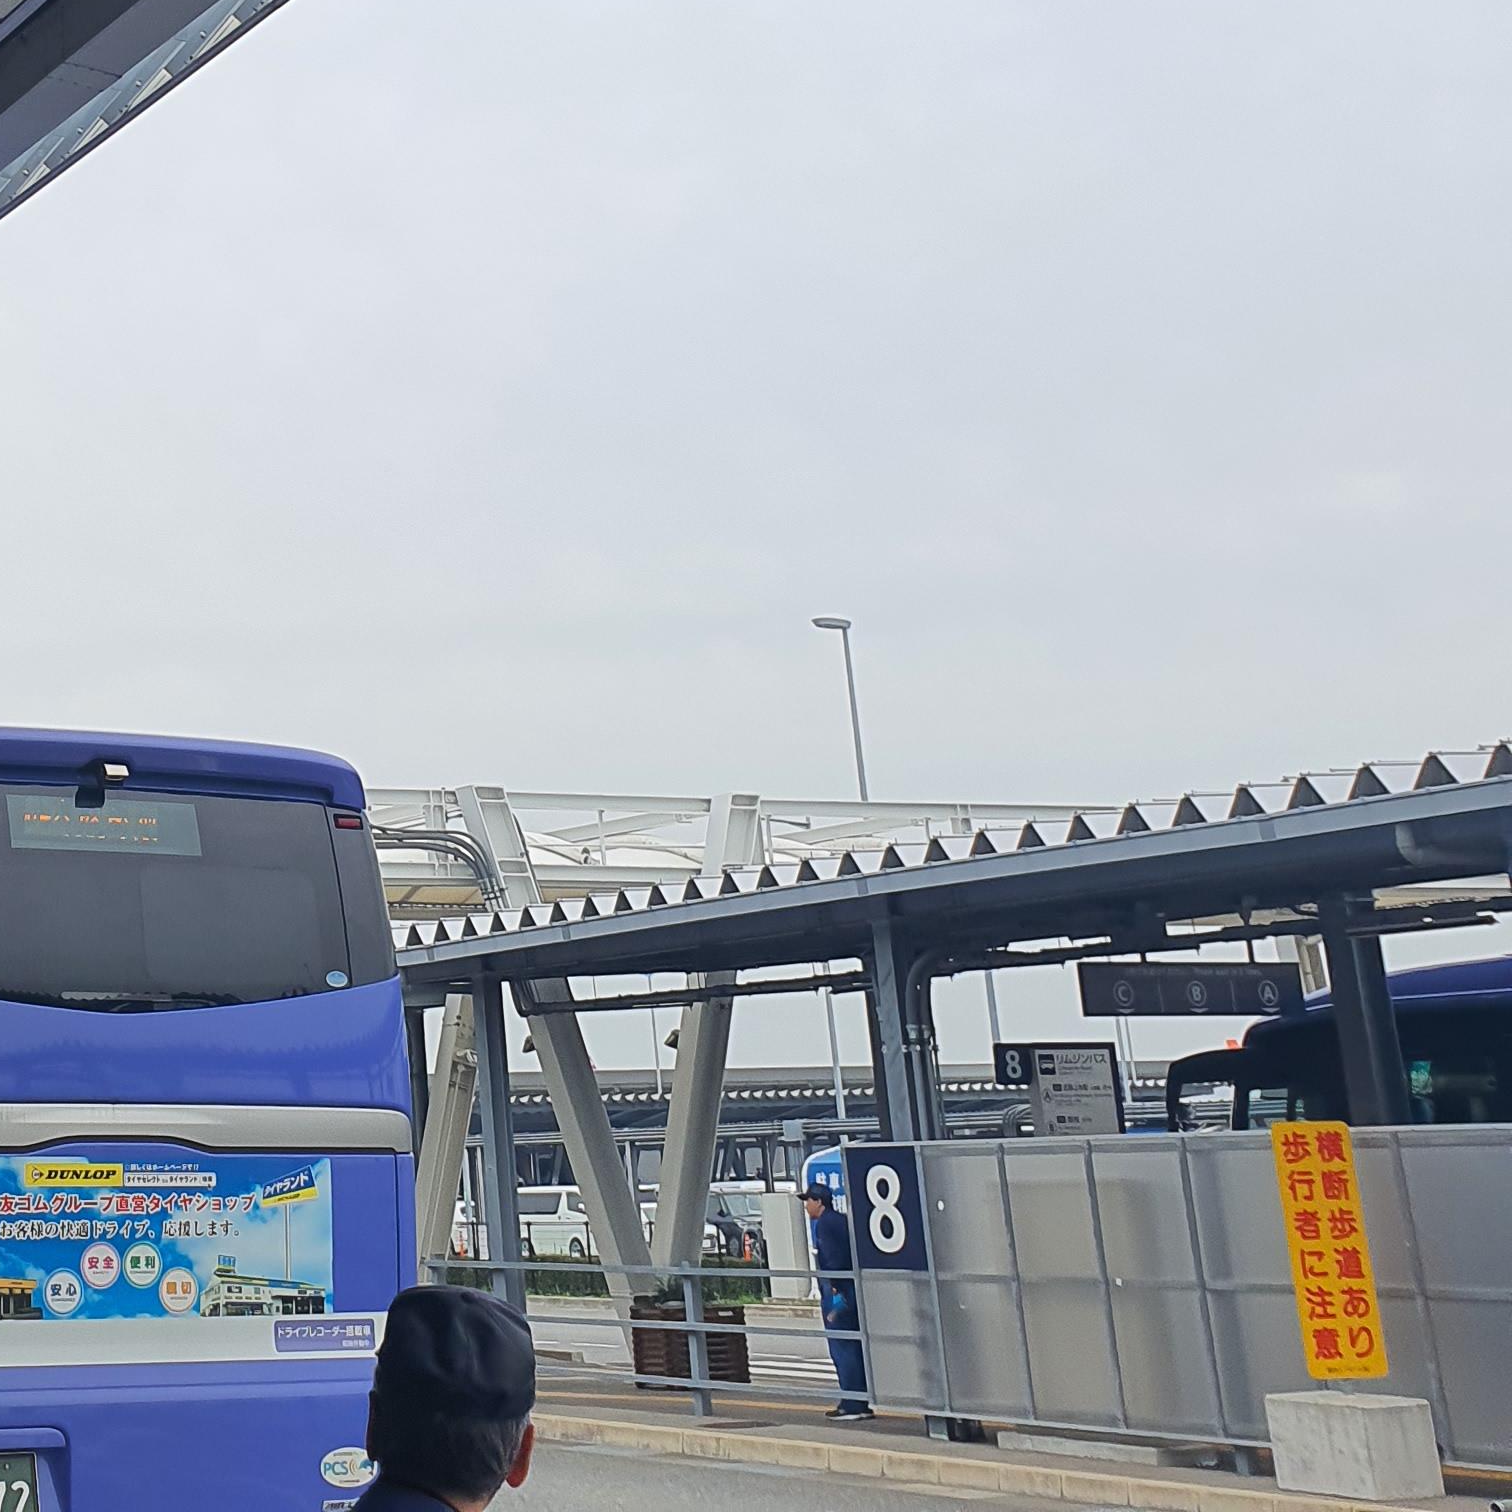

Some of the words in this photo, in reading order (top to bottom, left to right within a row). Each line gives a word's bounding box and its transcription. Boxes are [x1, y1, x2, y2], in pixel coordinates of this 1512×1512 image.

[1118, 986, 1129, 1001] C
[1192, 986, 1202, 1001] B
[1262, 984, 1275, 1001] A
[1005, 1050, 1022, 1078] 8
[45, 1169, 116, 1180] DUNLOP
[264, 1171, 309, 1198] タイヤランド
[867, 1164, 906, 1253] 8
[1281, 1130, 1343, 1361] 歩行者に注意
[1314, 1130, 1376, 1359] 横断歩道あり
[88, 1256, 114, 1270] 安全
[130, 1255, 155, 1269] 便利
[50, 1283, 77, 1297] 安心
[323, 1462, 348, 1476] PCS
